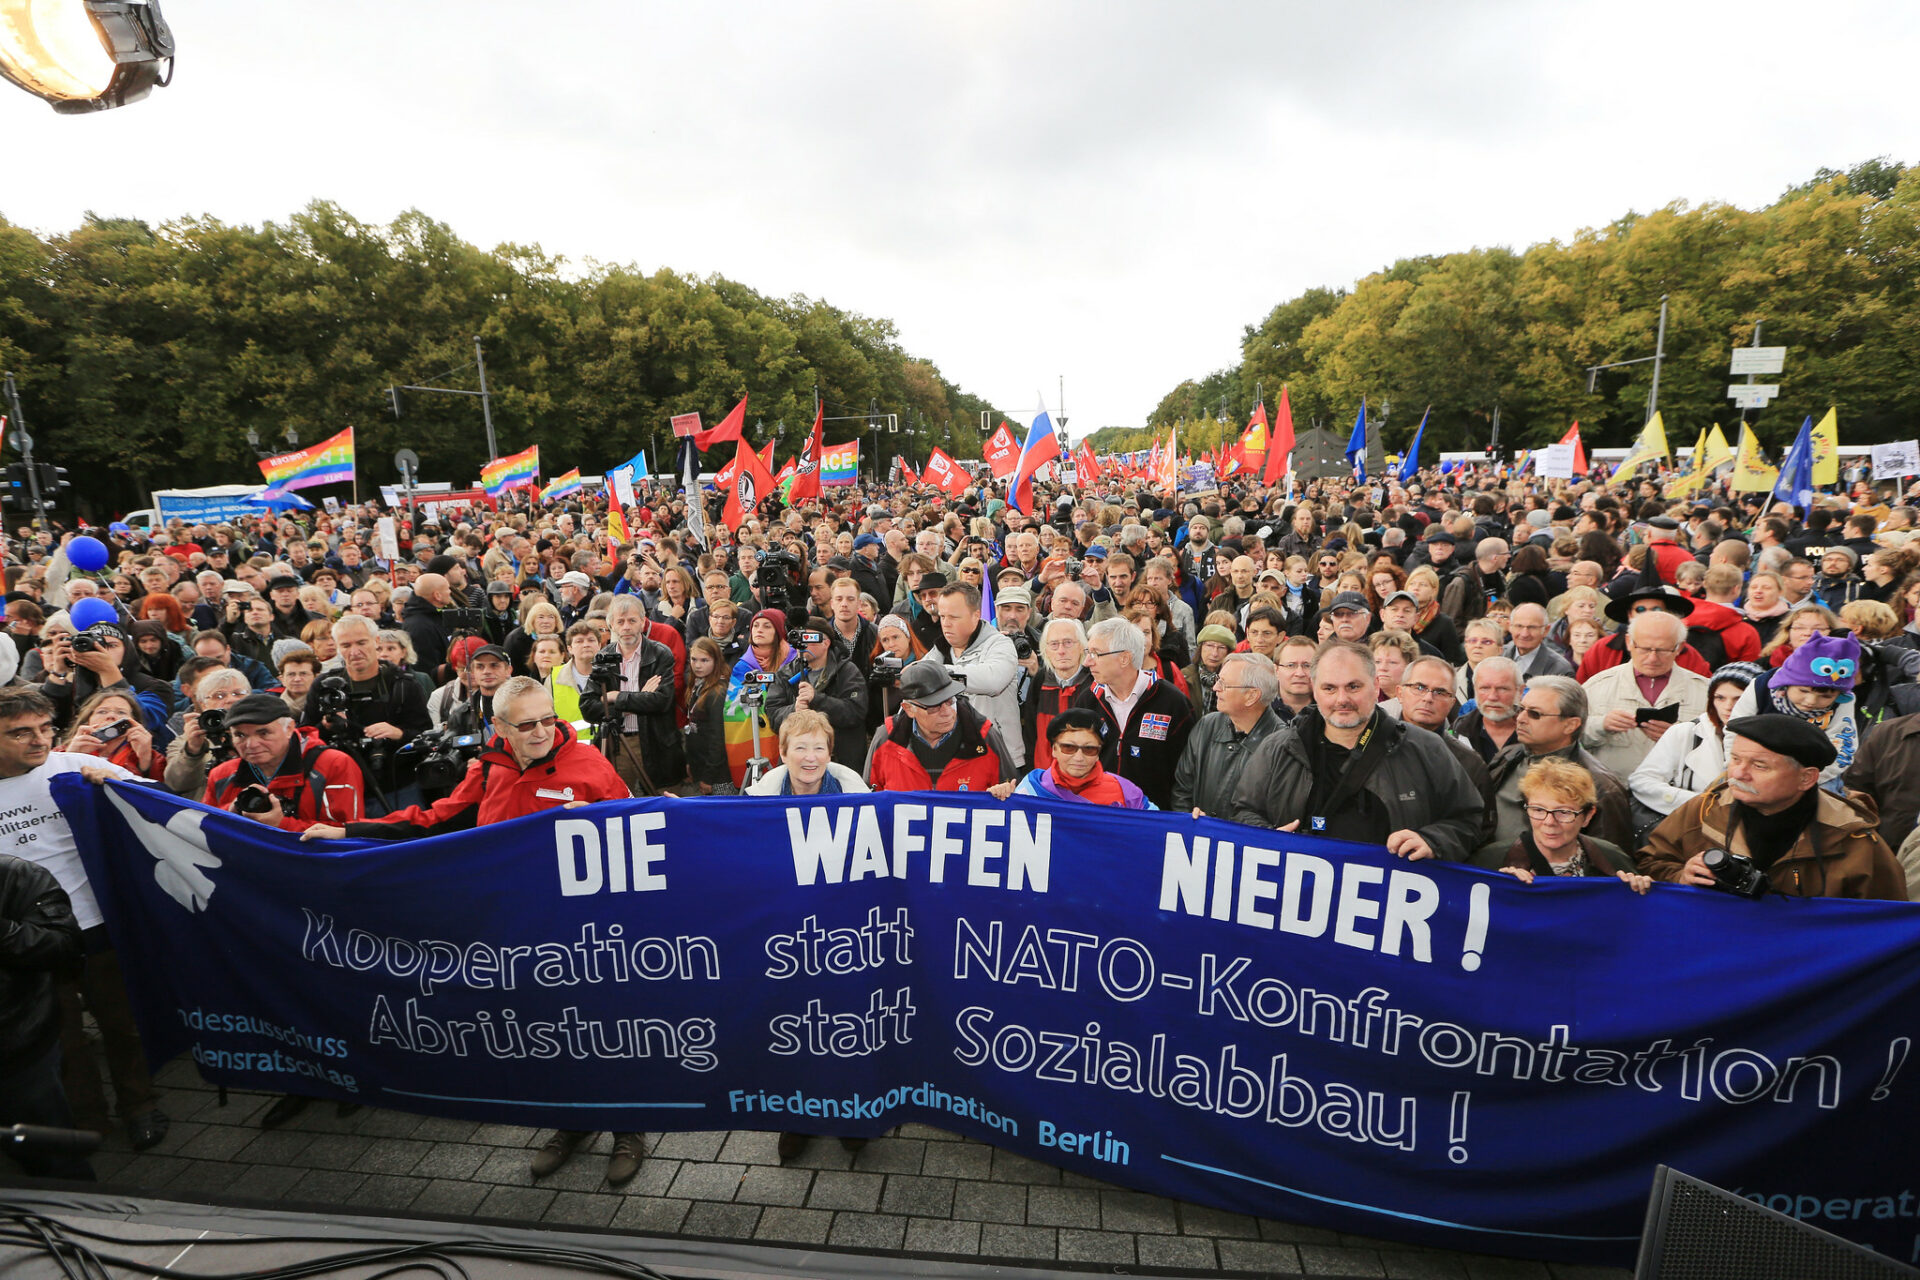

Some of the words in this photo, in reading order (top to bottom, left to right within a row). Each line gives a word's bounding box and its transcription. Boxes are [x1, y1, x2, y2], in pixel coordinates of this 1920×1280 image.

[15, 833, 38, 846] .de
[555, 811, 668, 898] DIE
[785, 803, 1052, 893] WAFFEN
[1158, 831, 1440, 964] NIEDER
[1461, 882, 1491, 973] !
[301, 908, 721, 997] Kooperation
[764, 905, 915, 980] statt
[952, 917, 1842, 1109] NATO-Konfrontation
[369, 994, 719, 1074] Abrüstung
[767, 985, 917, 1058] statt
[952, 1005, 1418, 1152] Sozialabbau
[729, 1081, 1019, 1137] Friedenskoordination
[1038, 1120, 1131, 1166] Berlin
